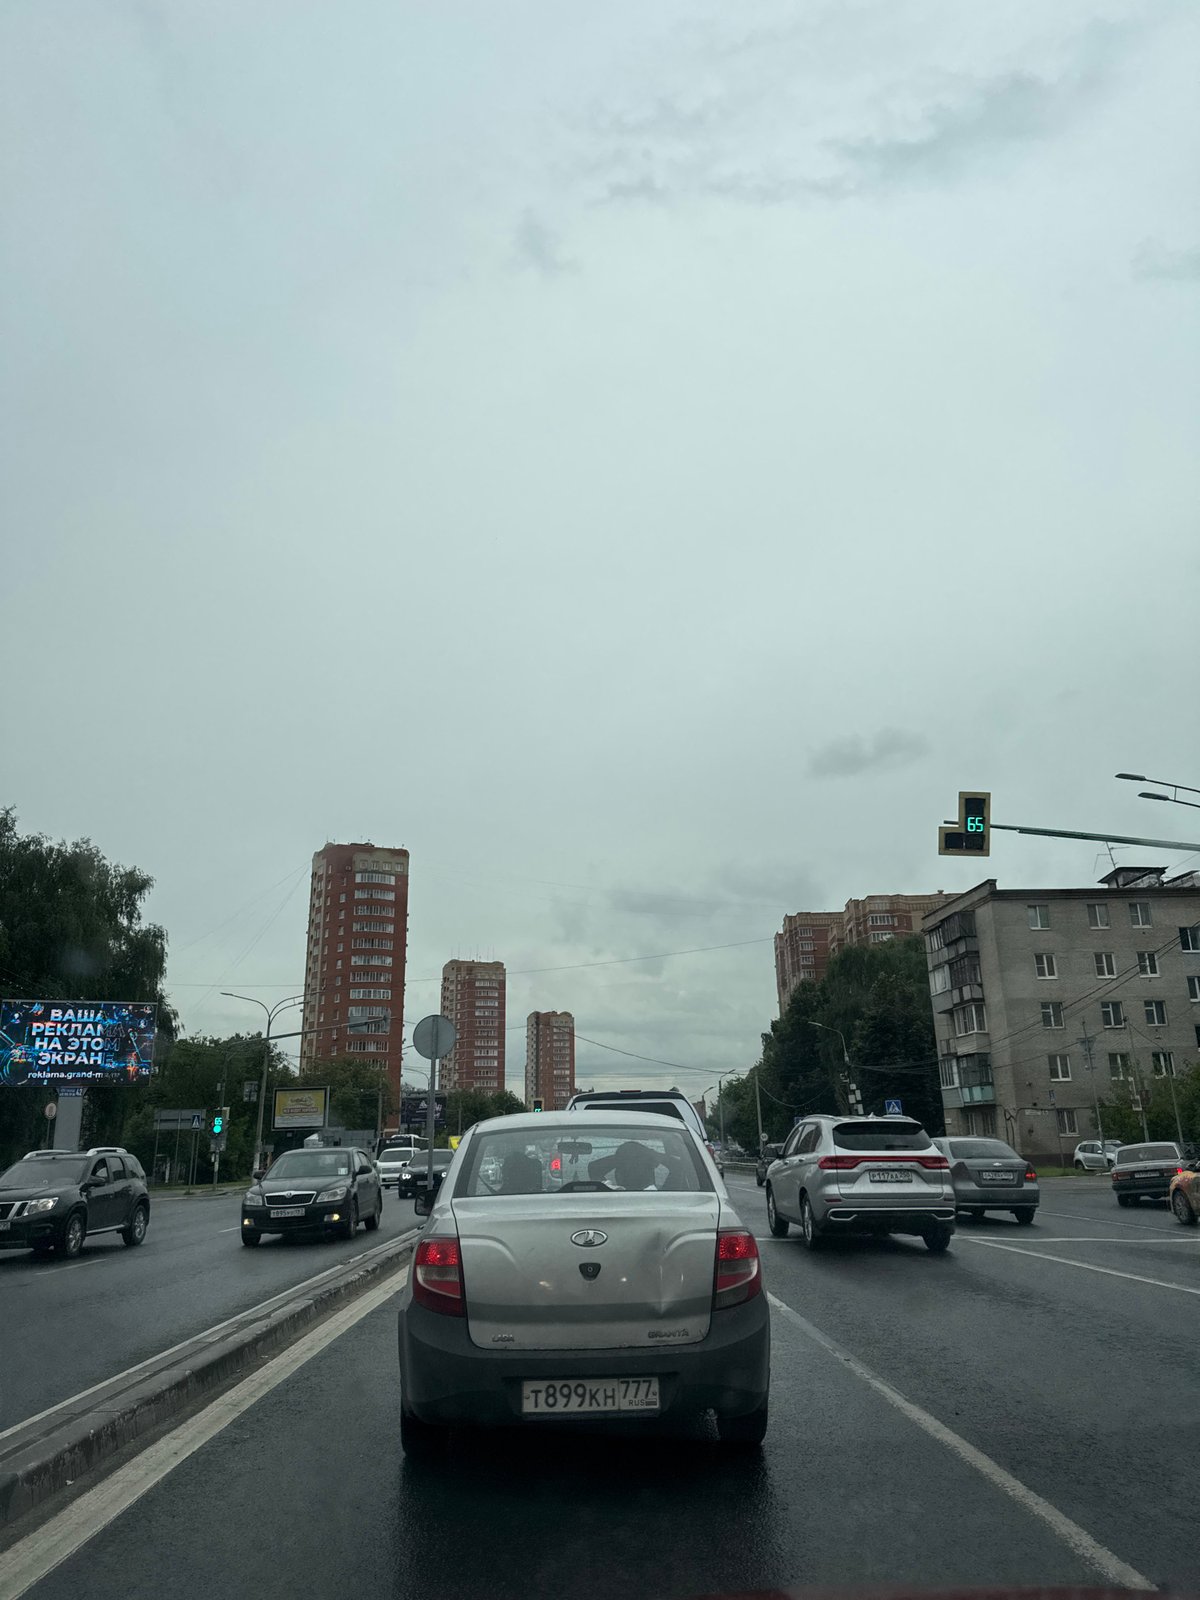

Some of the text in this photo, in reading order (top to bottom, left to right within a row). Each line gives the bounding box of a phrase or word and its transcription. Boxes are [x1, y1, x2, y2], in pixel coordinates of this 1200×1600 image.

[967, 816, 984, 832] 65
[50, 1008, 107, 1022] ВАША
[31, 1022, 125, 1037] РЕКЛАМА
[34, 1037, 119, 1051] НА ЭТОМ
[38, 1051, 114, 1066] ЭКРАНЕ
[214, 1117, 223, 1126] 65
[491, 1334, 515, 1343] LADA
[647, 1328, 690, 1339] GRANTA
[531, 1380, 652, 1408] Т899КН 777
